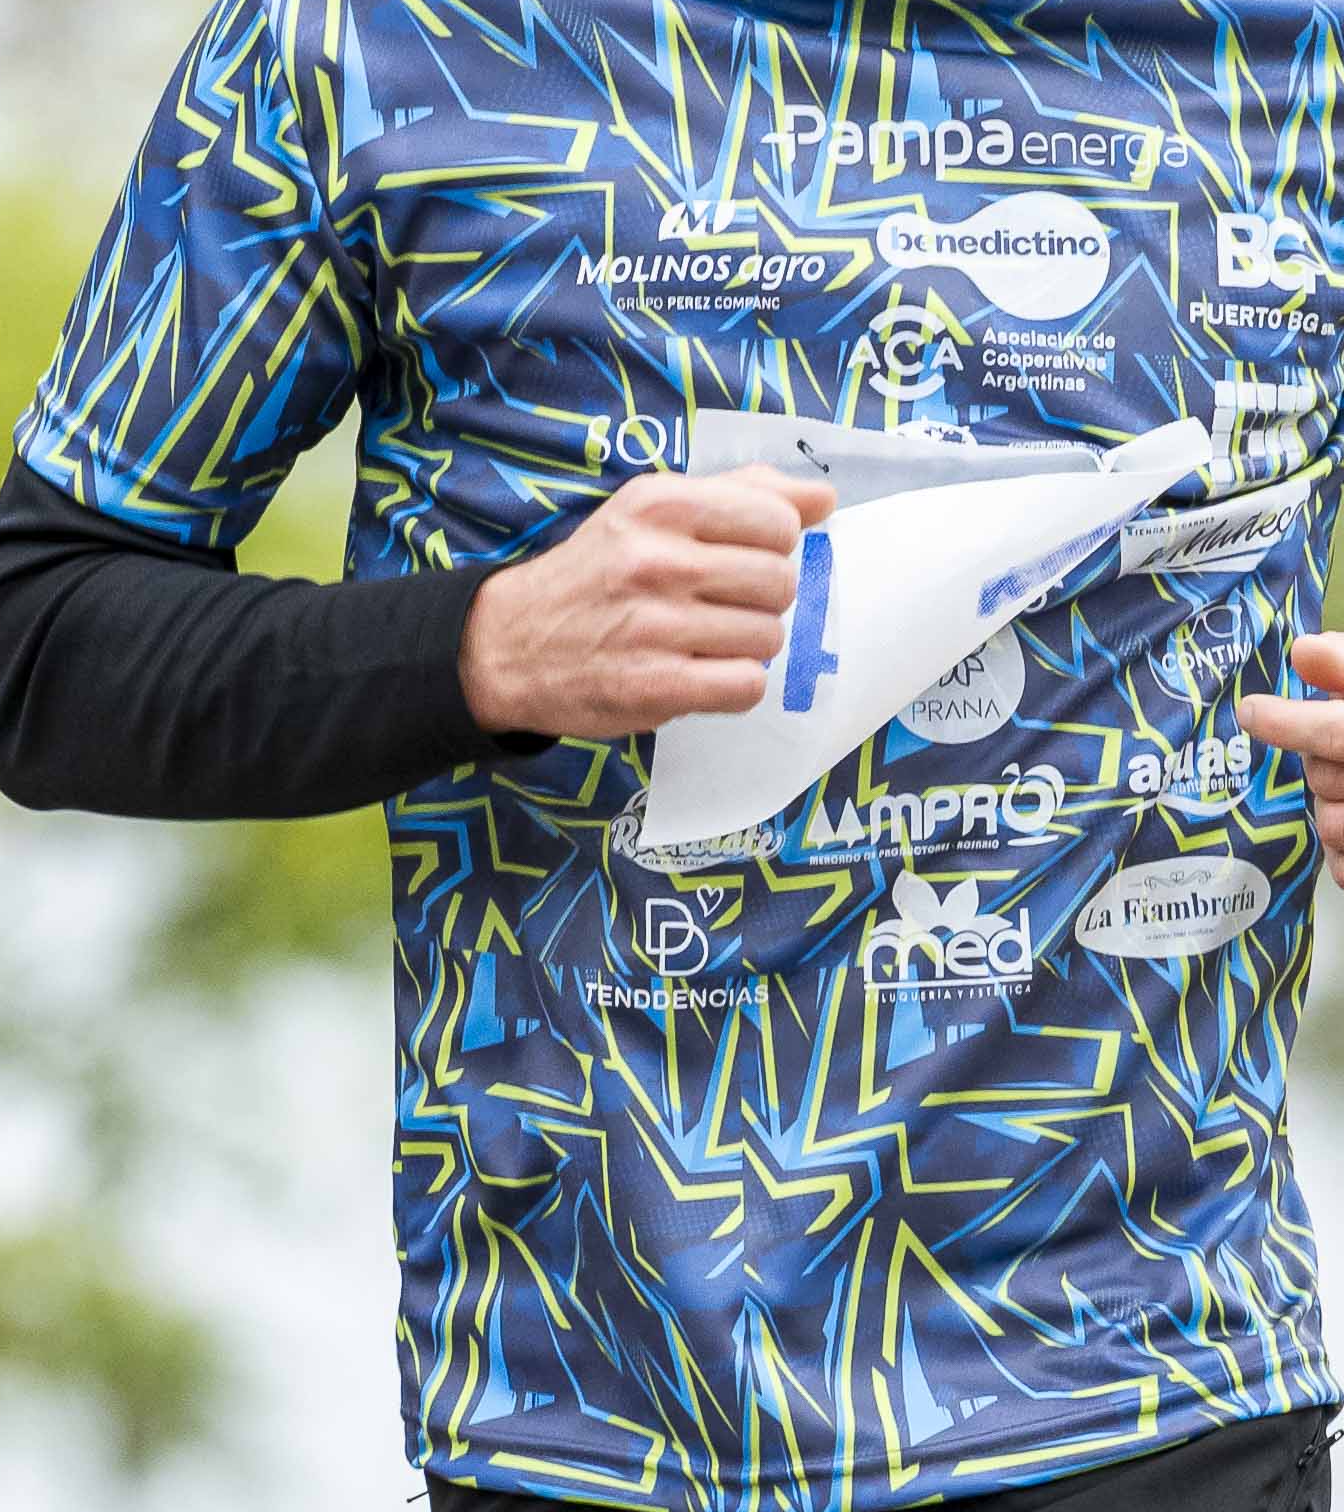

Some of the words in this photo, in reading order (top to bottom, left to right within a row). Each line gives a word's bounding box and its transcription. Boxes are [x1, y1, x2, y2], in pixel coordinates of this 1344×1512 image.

[576, 255, 731, 285] MOLINOS
[737, 253, 826, 291] agro
[616, 296, 663, 311] GRUPO
[714, 296, 781, 311] COMPANC
[1189, 301, 1283, 330] PUERTO
[1287, 311, 1319, 334] BG
[846, 329, 964, 377] ACA
[1092, 332, 1116, 350] de
[982, 348, 1107, 371] Cooperativas
[982, 371, 1086, 393] Argentinas
[912, 698, 1001, 724] PRANA
[1084, 907, 1112, 931] La
[585, 982, 769, 1010] TENDDENCIAS
